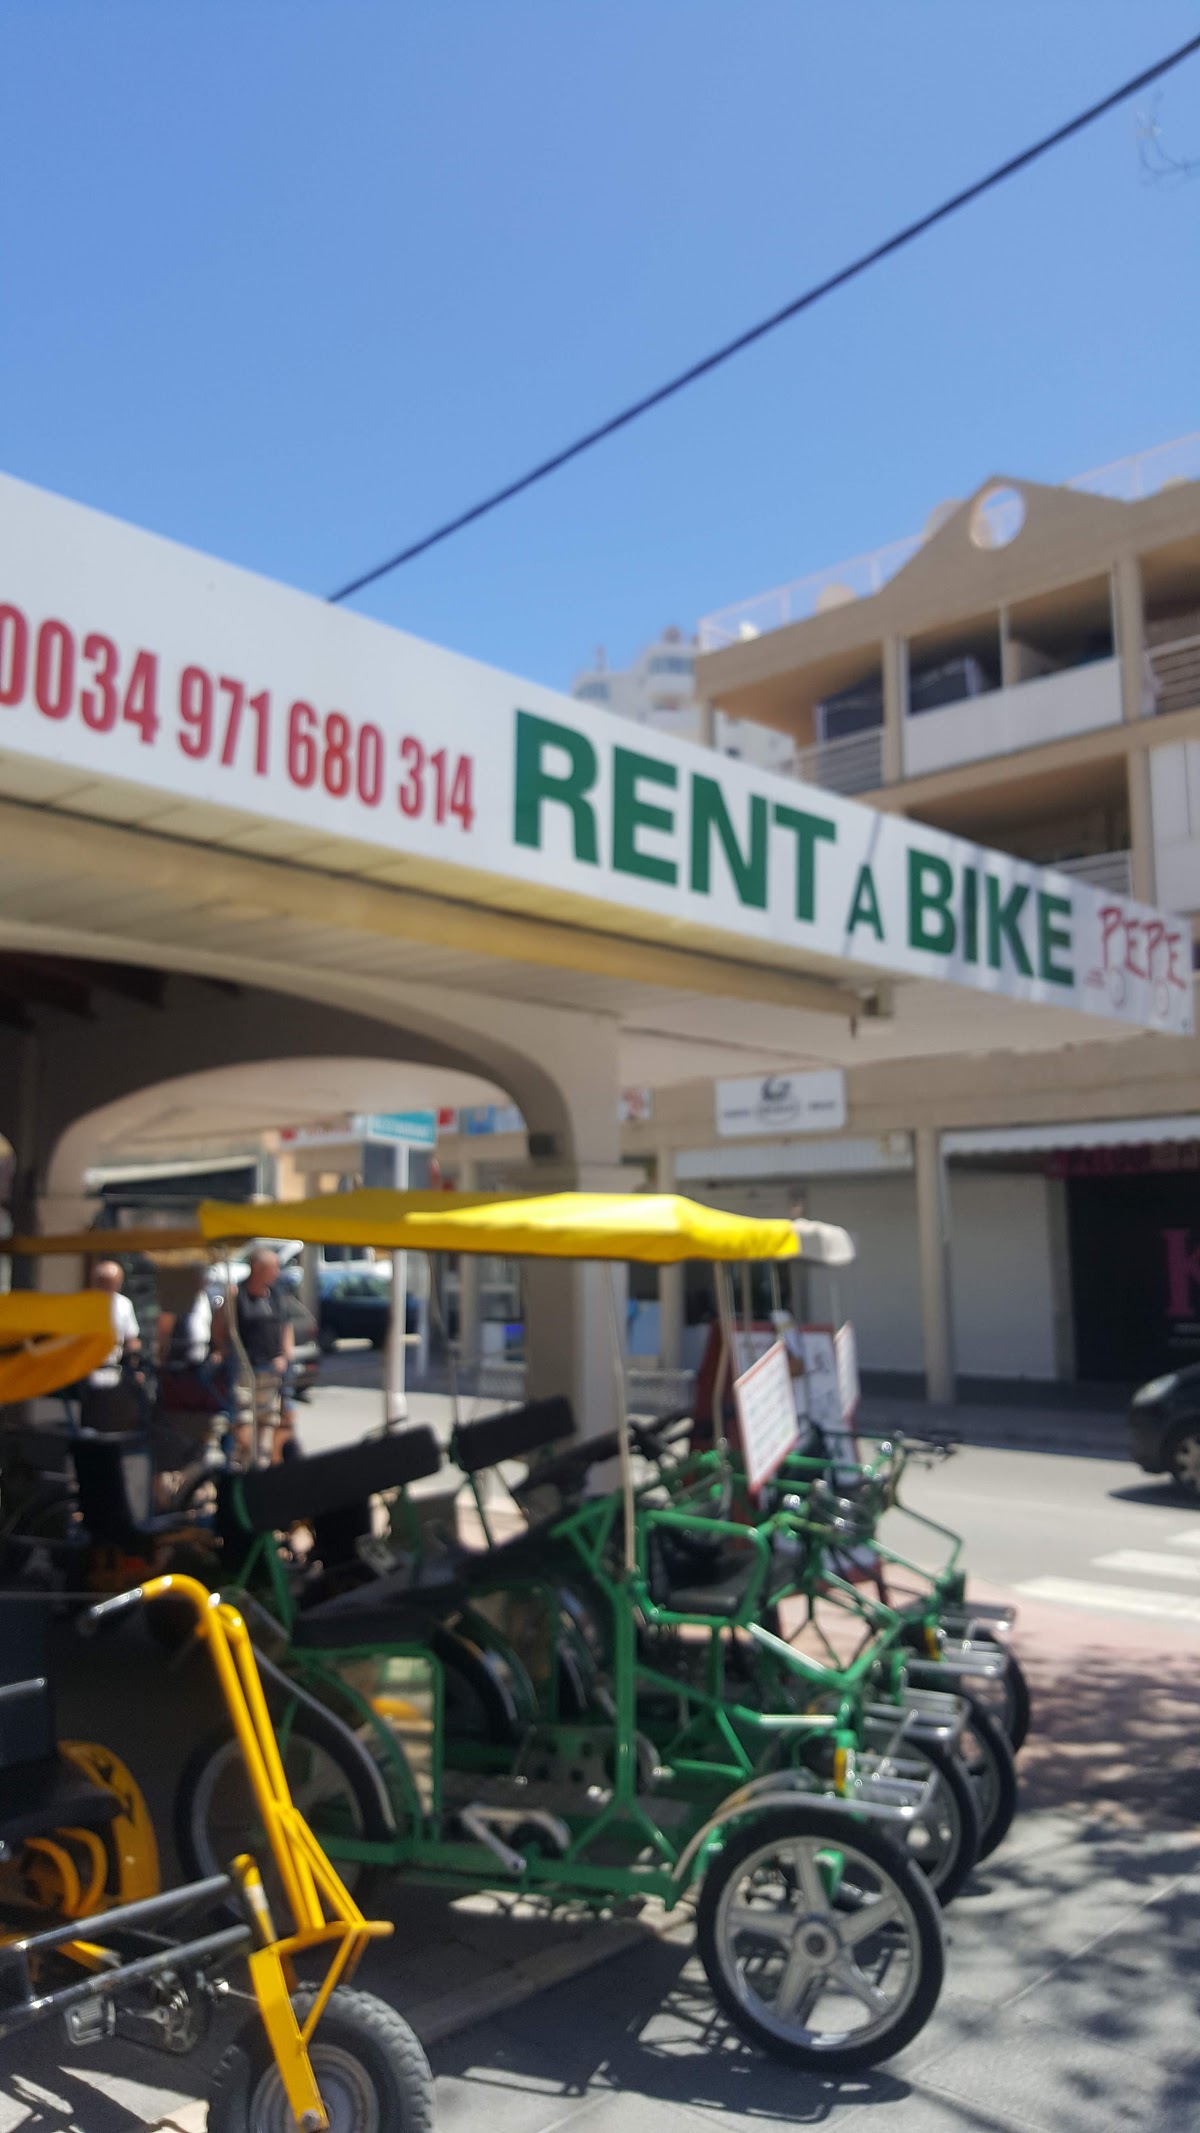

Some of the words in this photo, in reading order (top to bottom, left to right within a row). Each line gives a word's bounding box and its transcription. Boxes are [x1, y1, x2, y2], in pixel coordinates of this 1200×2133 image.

[0, 604, 160, 745] 0034
[177, 665, 271, 777] 971
[286, 701, 385, 808] 680
[398, 735, 475, 832] 314
[512, 708, 838, 925] RENT
[846, 864, 885, 943] A
[906, 847, 1076, 988] BIKE
[1098, 906, 1187, 990] PEPE
